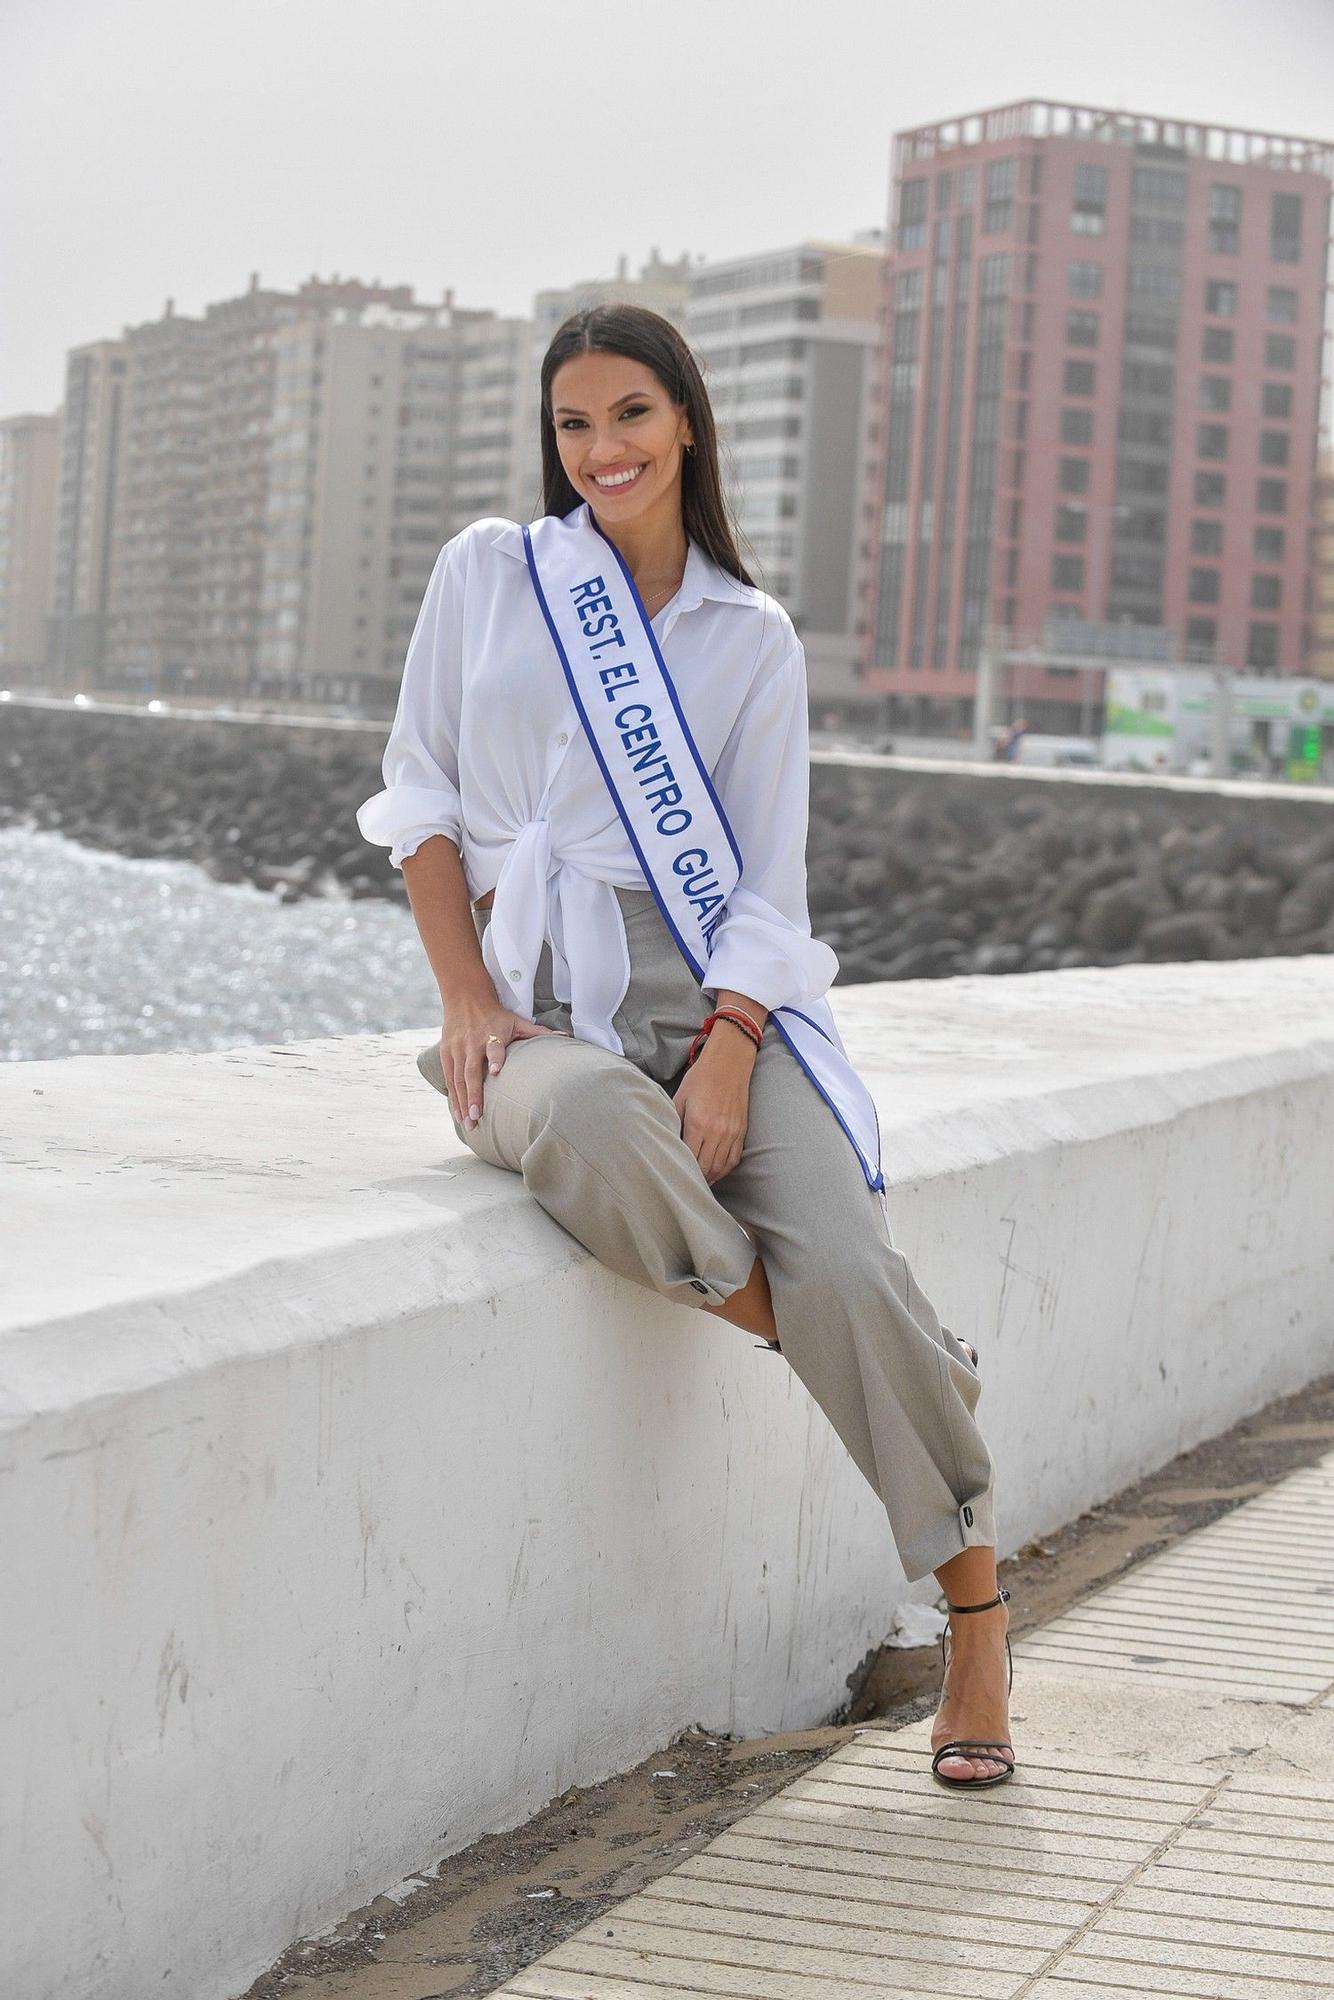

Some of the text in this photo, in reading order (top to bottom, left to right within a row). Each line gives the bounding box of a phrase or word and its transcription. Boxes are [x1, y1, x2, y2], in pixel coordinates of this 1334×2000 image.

[570, 575, 626, 660] REST.
[599, 662, 640, 702] EL
[615, 704, 693, 836] CENTRO
